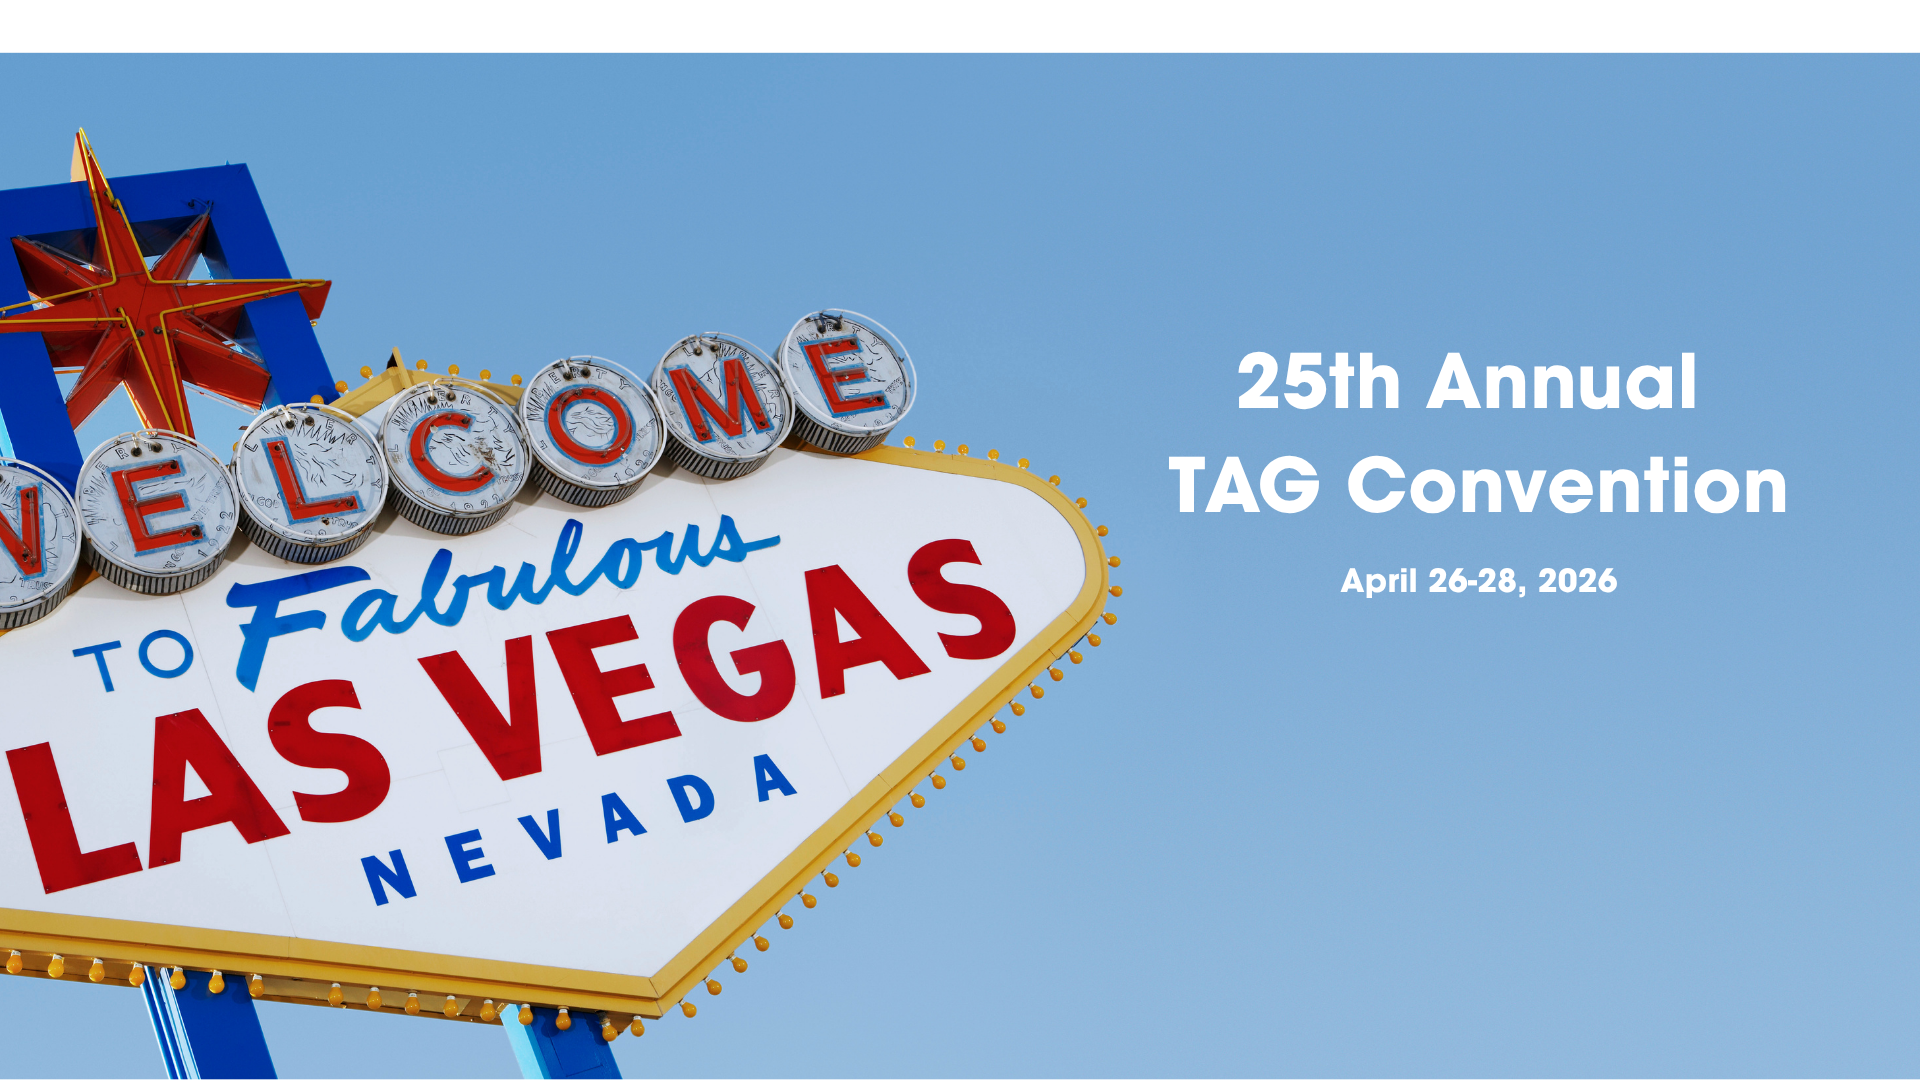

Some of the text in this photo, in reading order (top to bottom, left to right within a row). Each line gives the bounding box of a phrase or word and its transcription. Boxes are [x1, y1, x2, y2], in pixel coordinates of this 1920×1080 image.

[73, 514, 780, 692] TO Fabulous
[197, 510, 234, 558] 1922
[5, 538, 1016, 895] LAS VEGAS
[360, 753, 798, 906] NEVADA
